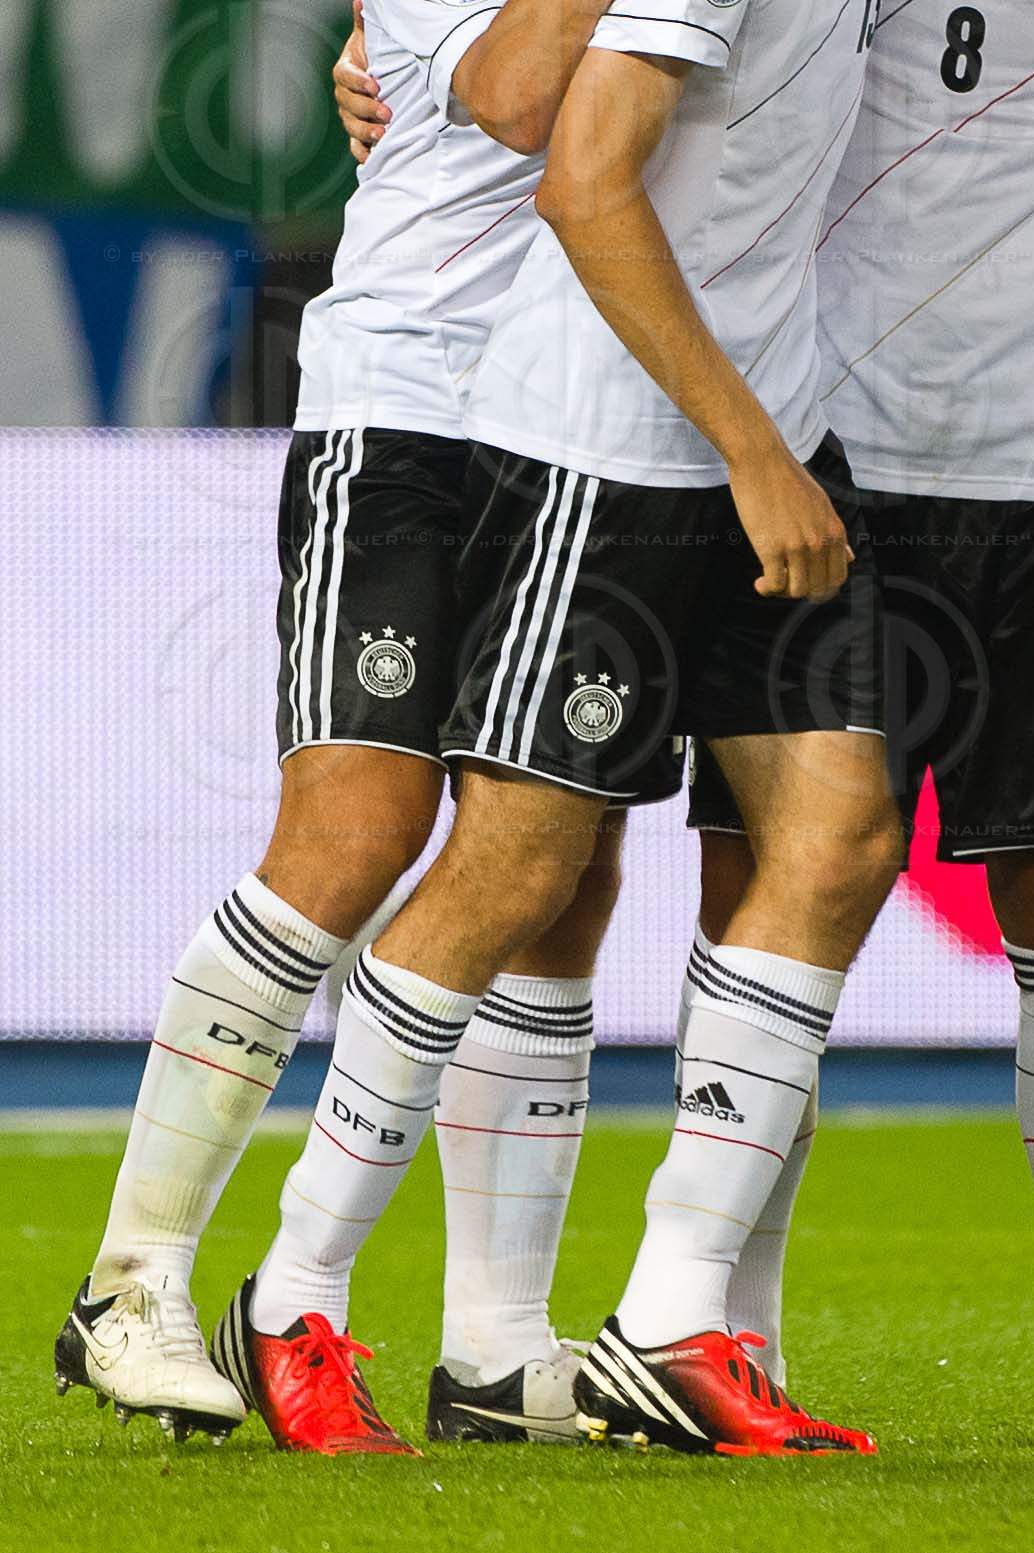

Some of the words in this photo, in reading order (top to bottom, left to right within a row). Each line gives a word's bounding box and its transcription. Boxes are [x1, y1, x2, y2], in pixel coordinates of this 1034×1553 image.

[940, 6, 986, 94] 8
[207, 1022, 290, 1070] DFB
[333, 1096, 406, 1147] DFB
